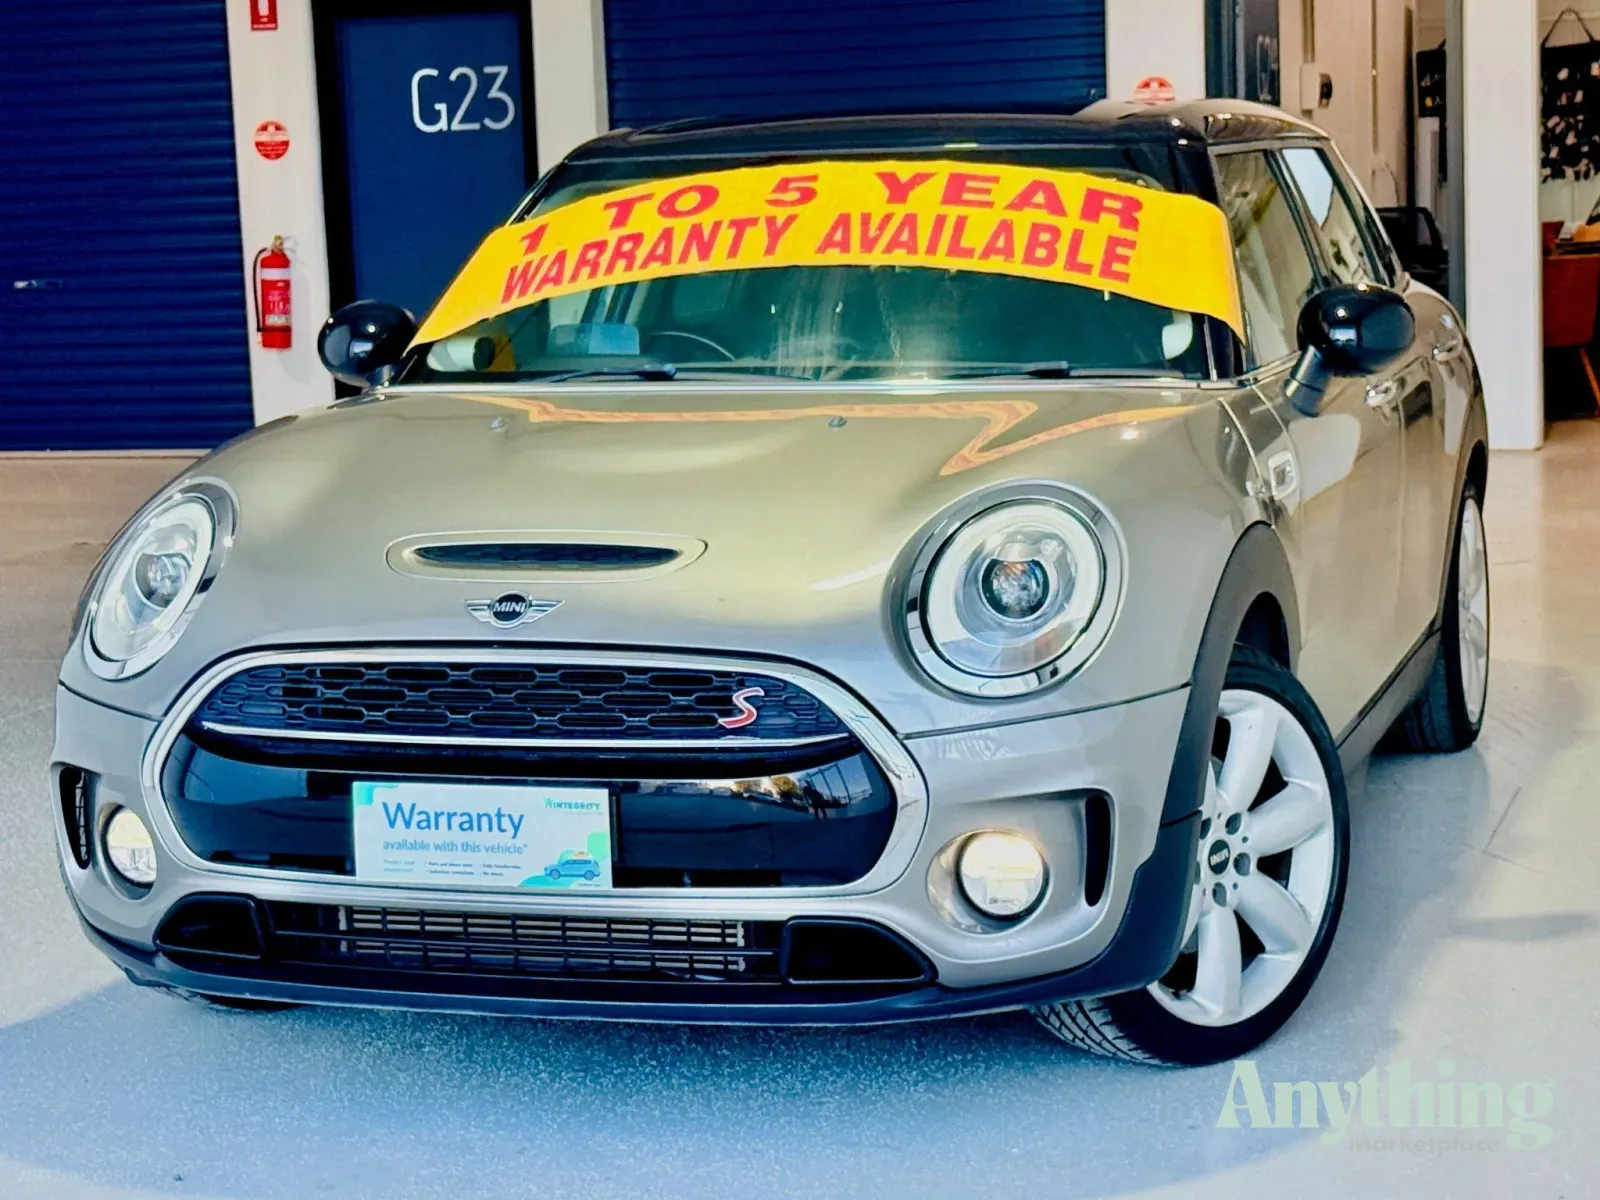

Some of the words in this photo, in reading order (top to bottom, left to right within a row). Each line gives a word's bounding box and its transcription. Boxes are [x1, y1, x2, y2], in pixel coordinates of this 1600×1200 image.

[411, 65, 516, 133] G23
[518, 223, 549, 256] 1
[602, 184, 720, 230] TO
[764, 173, 820, 208] 5
[874, 171, 1144, 232] YEAR
[501, 213, 800, 304] WARRANTY
[815, 212, 1137, 284] AVAILABLE
[493, 601, 526, 614] MINI
[717, 686, 765, 729] S
[381, 801, 525, 839] Warranty
[383, 839, 431, 851] available
[433, 840, 458, 853] with
[461, 841, 481, 853] this
